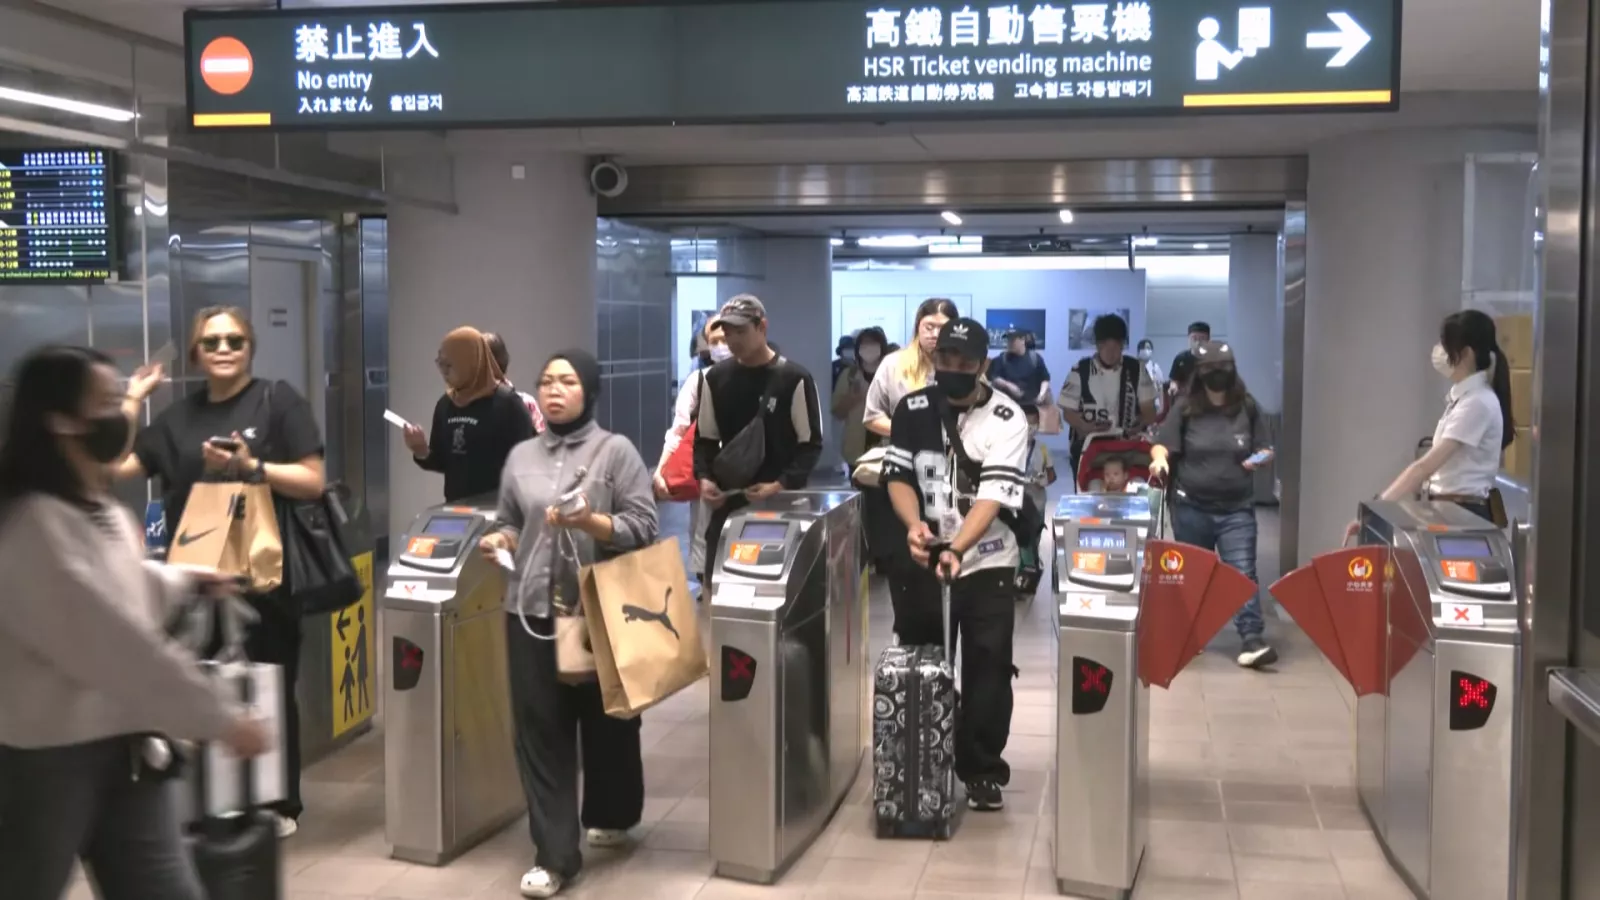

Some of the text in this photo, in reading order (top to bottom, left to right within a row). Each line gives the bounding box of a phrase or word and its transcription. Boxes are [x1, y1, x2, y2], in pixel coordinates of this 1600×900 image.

[865, 1, 1153, 48] 高鐵自動售票機
[295, 22, 439, 62] 禁止進入
[864, 50, 1152, 78] HSR Ticket vending machine
[297, 70, 373, 93] No entry
[1013, 80, 1074, 100] 고속철도
[298, 95, 374, 114] 入れません
